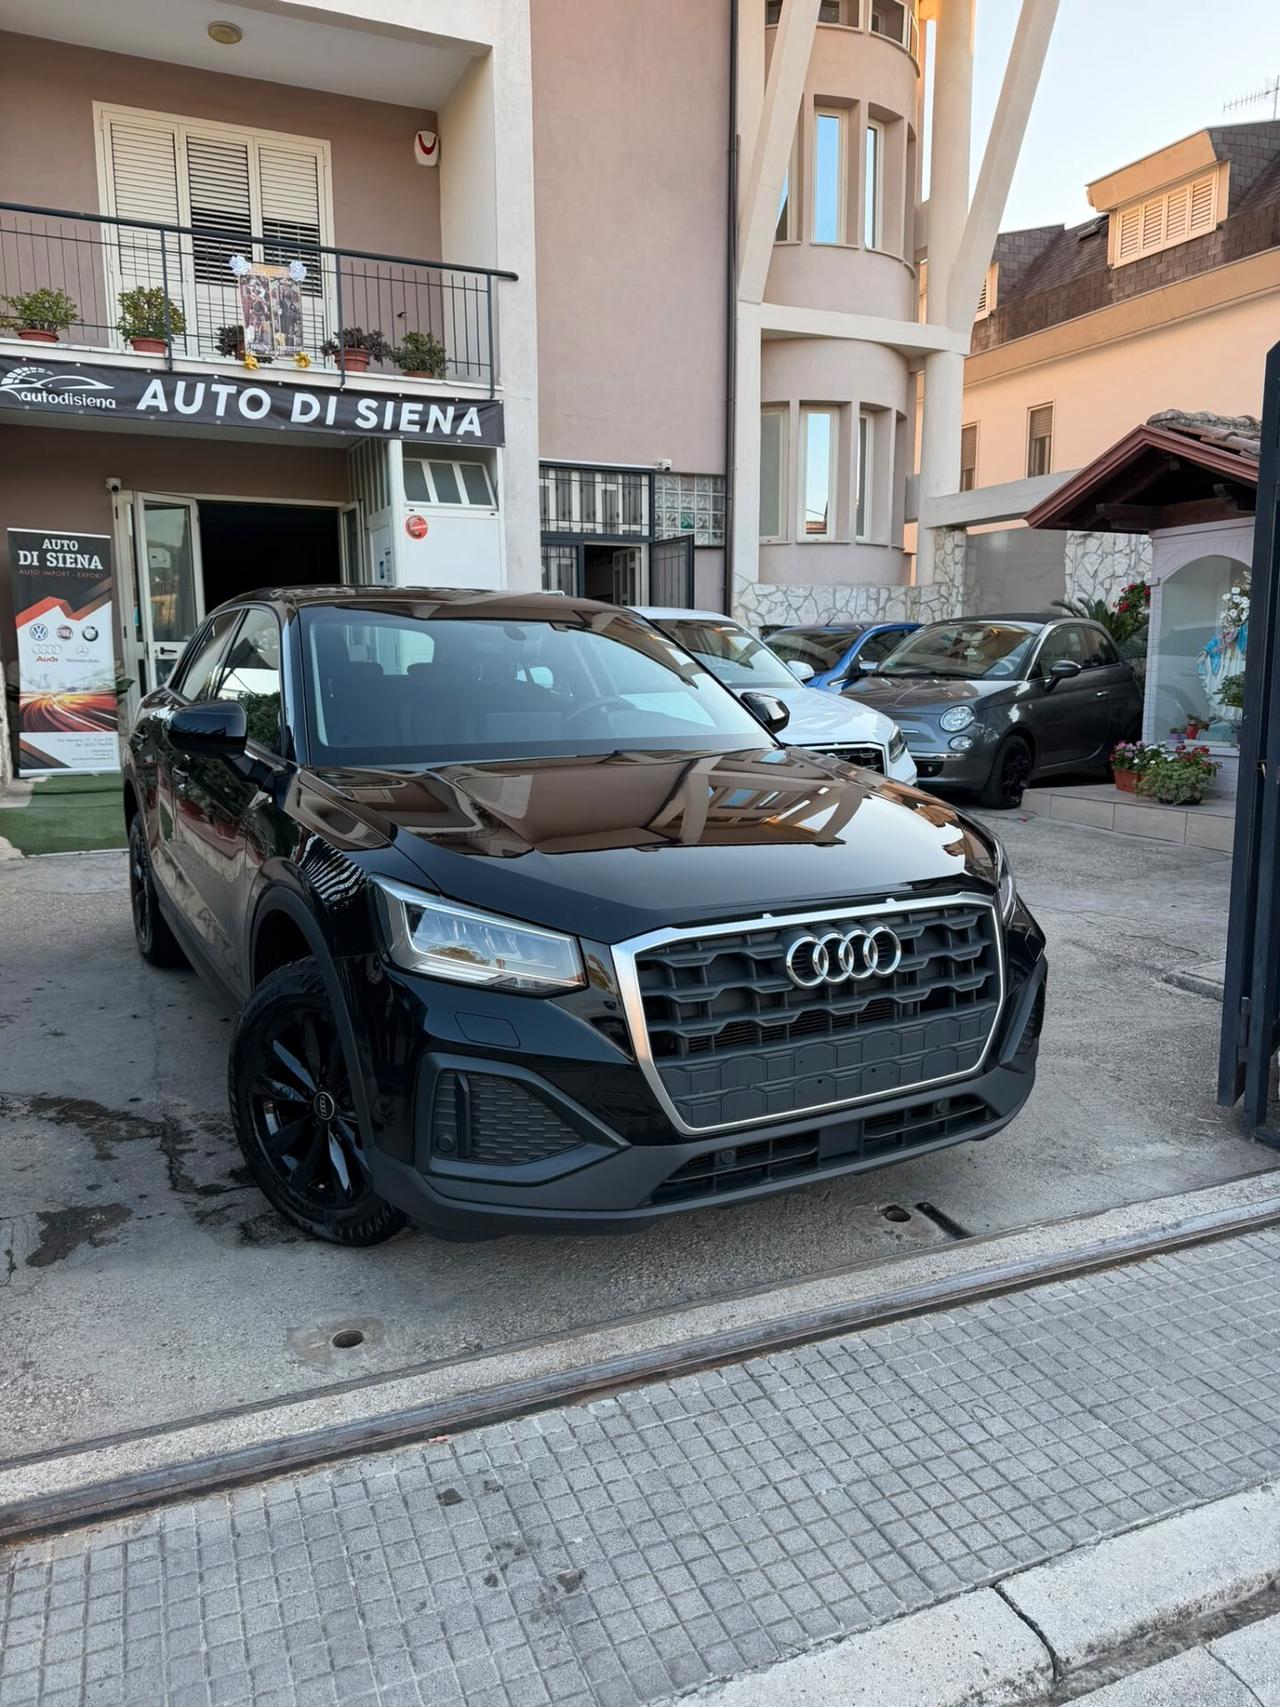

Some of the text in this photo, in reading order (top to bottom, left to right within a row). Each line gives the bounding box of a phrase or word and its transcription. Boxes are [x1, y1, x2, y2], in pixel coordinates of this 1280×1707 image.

[21, 391, 116, 409] autodisiena
[136, 378, 483, 437] AUTO DI SIENA
[42, 538, 79, 551] AUTO
[17, 550, 104, 570] DI SIENA
[42, 569, 70, 577] IMPORT
[77, 571, 104, 579] EXPORT
